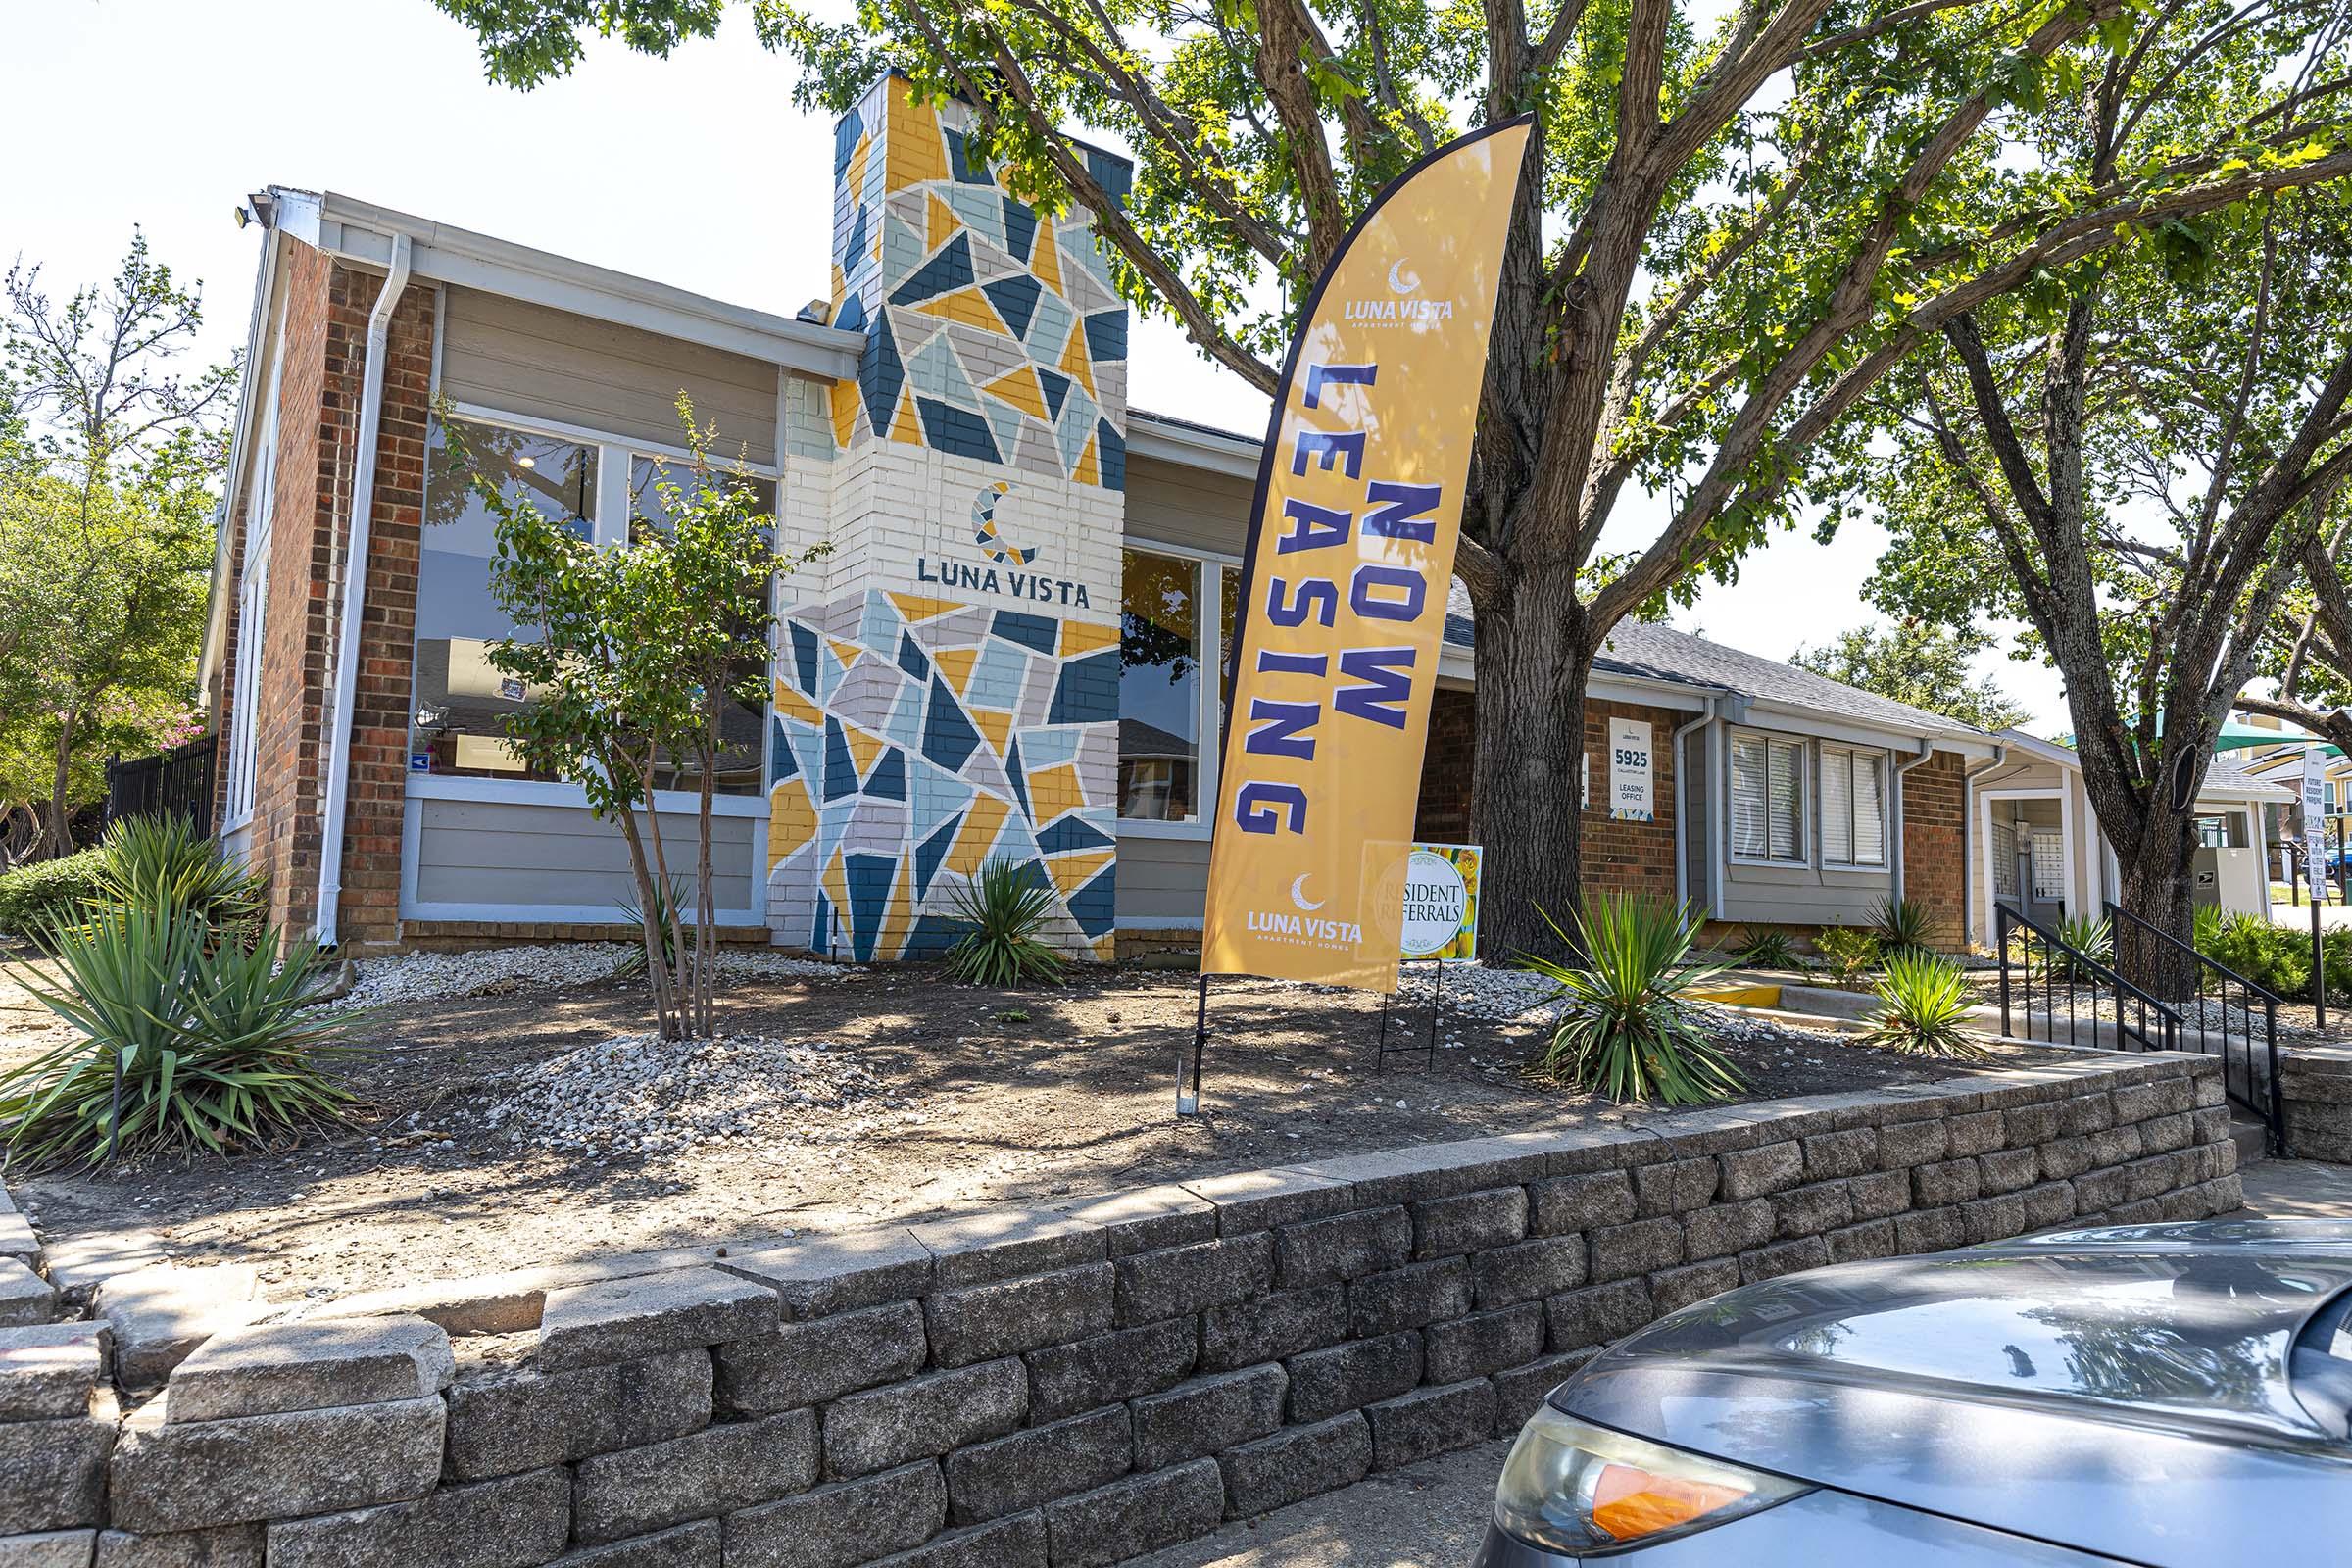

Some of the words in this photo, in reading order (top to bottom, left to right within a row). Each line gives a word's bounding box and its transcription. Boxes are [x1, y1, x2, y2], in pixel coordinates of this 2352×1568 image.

[1344, 300, 1396, 319] LUNA
[1399, 299, 1453, 320] VISTA
[918, 557, 1001, 594] LUNA
[1008, 571, 1090, 609] VISTA
[1234, 362, 1379, 836] LEASING
[1333, 479, 1443, 731] NOW
[1615, 748, 1647, 768] 5925
[1619, 783, 1644, 794] LEASING
[1621, 793, 1643, 802] OFFICE
[1247, 910, 1301, 935] LUNA
[1305, 917, 1363, 944] VISTA
[1256, 934, 1313, 947] APARTMENT
[1318, 942, 1349, 952] HOMES
